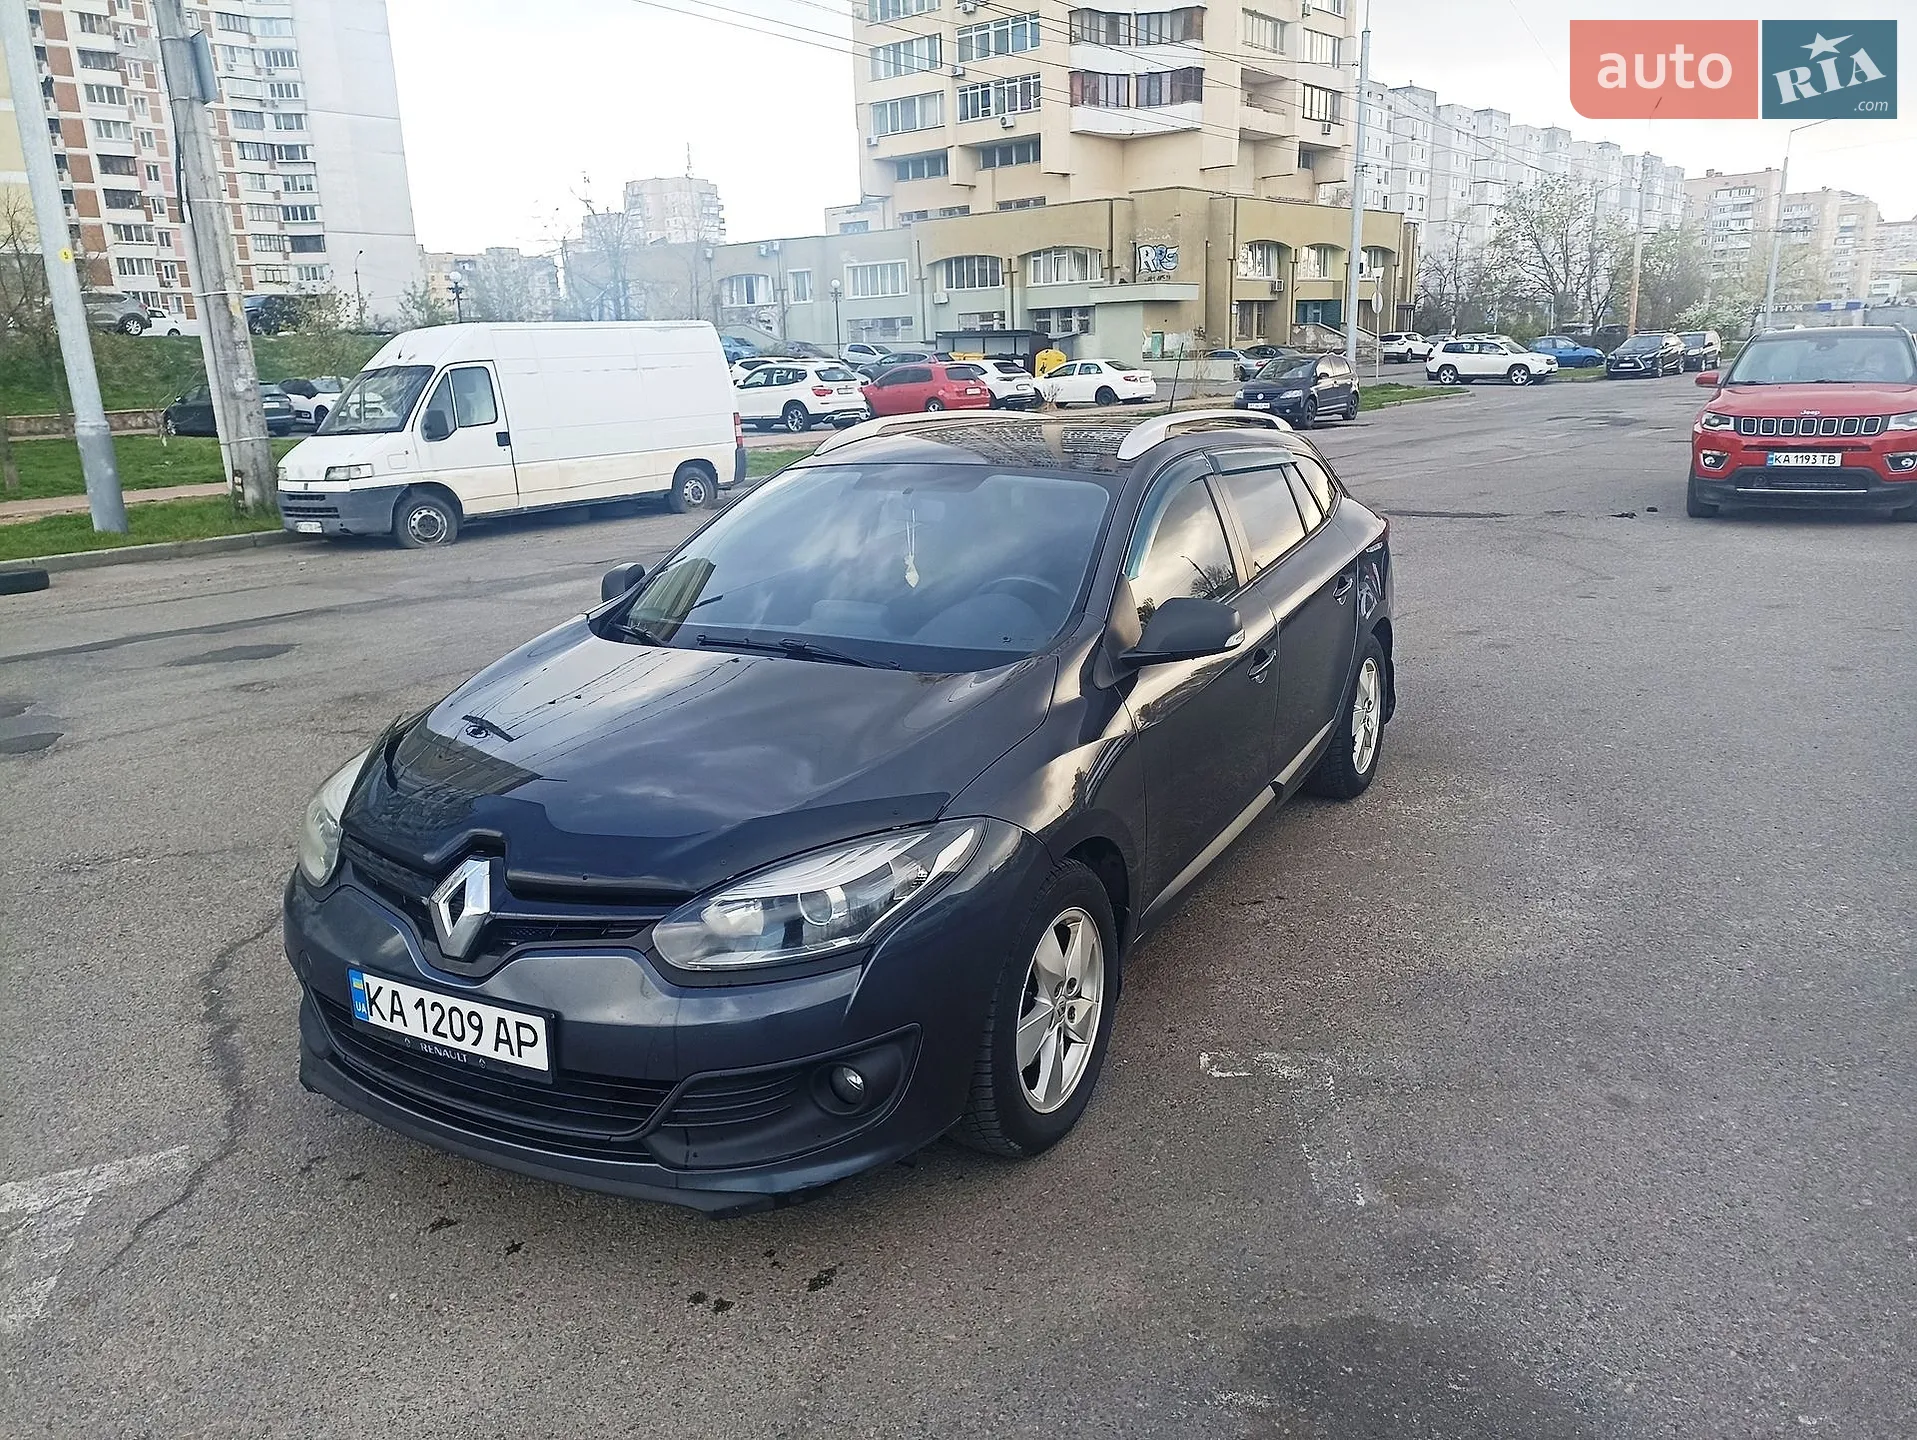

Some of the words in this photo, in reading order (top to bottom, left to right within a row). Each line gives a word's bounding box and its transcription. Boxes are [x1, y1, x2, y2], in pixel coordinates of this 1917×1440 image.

[1774, 454, 1791, 464] KA
[1793, 454, 1817, 465] 1193
[1820, 454, 1836, 465] TB
[355, 1001, 367, 1014] UA
[365, 982, 408, 1028] KA
[413, 997, 484, 1047] 1209
[493, 1017, 538, 1058] AP
[420, 1042, 467, 1063] RENAULT
